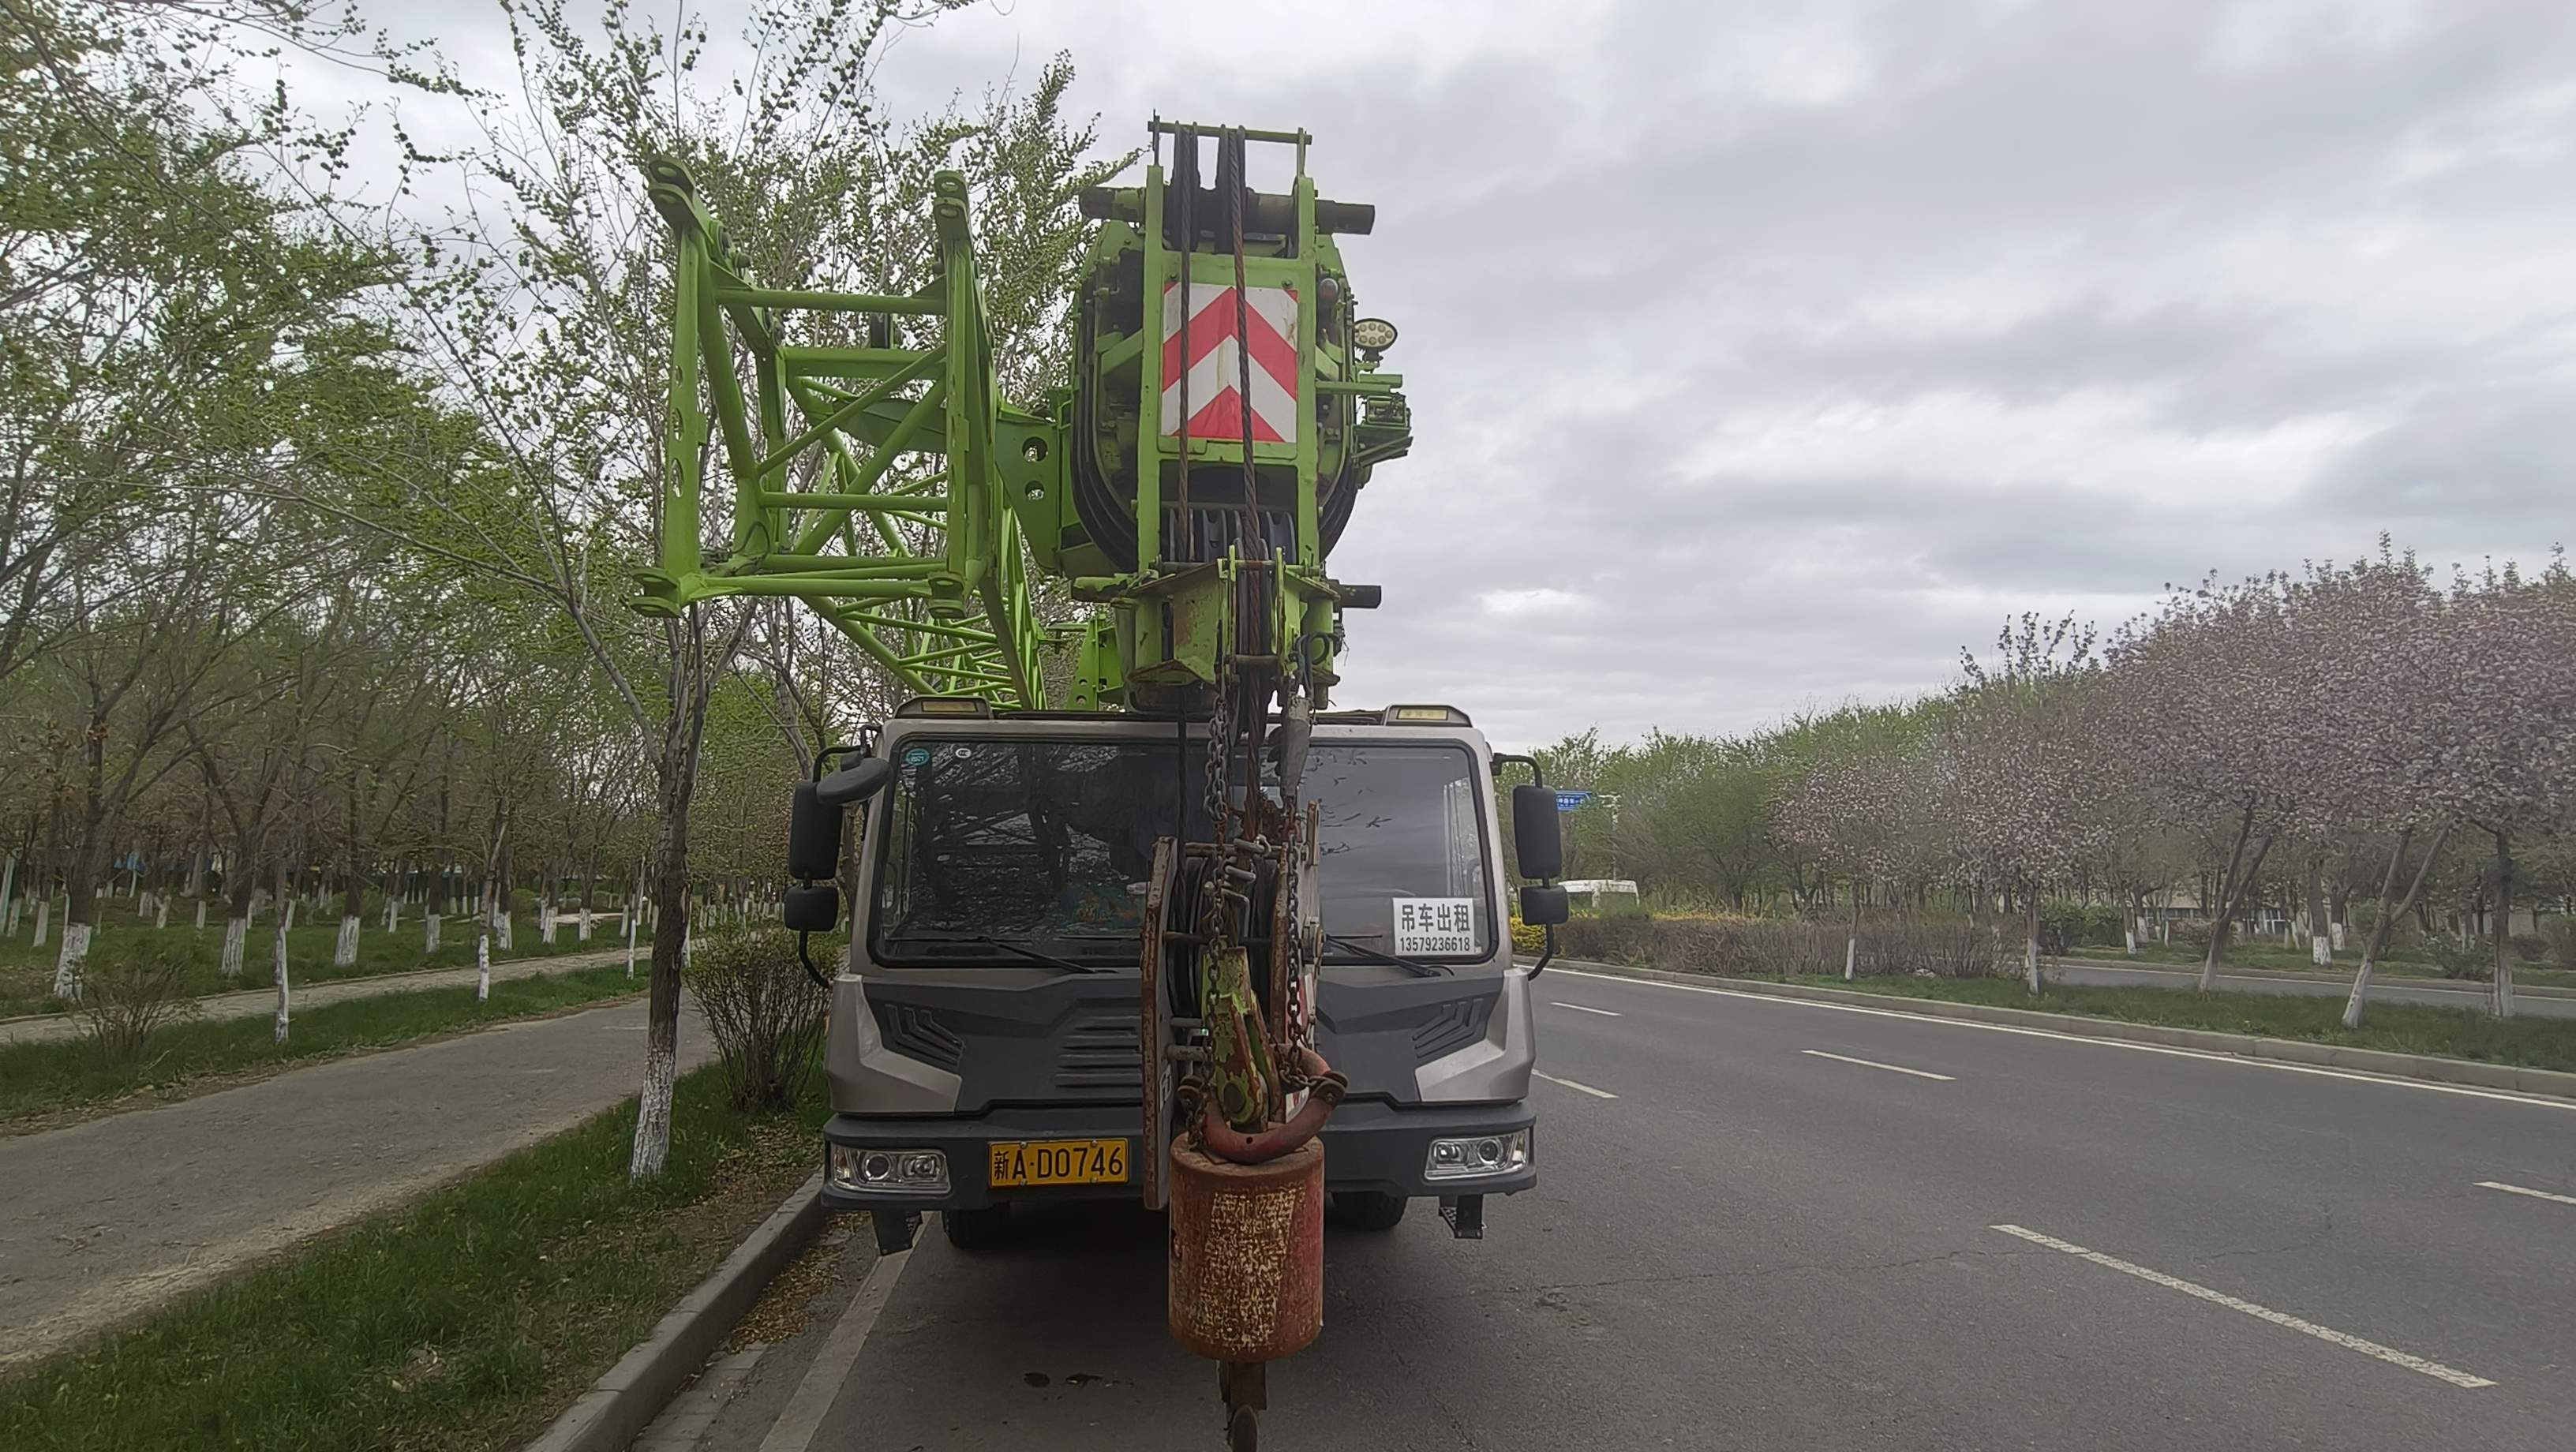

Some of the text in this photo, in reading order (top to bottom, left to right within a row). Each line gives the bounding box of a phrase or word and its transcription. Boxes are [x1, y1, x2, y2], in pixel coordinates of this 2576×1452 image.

[1401, 903, 1470, 932] 吊车出租
[1399, 937, 1470, 952] 13579236618
